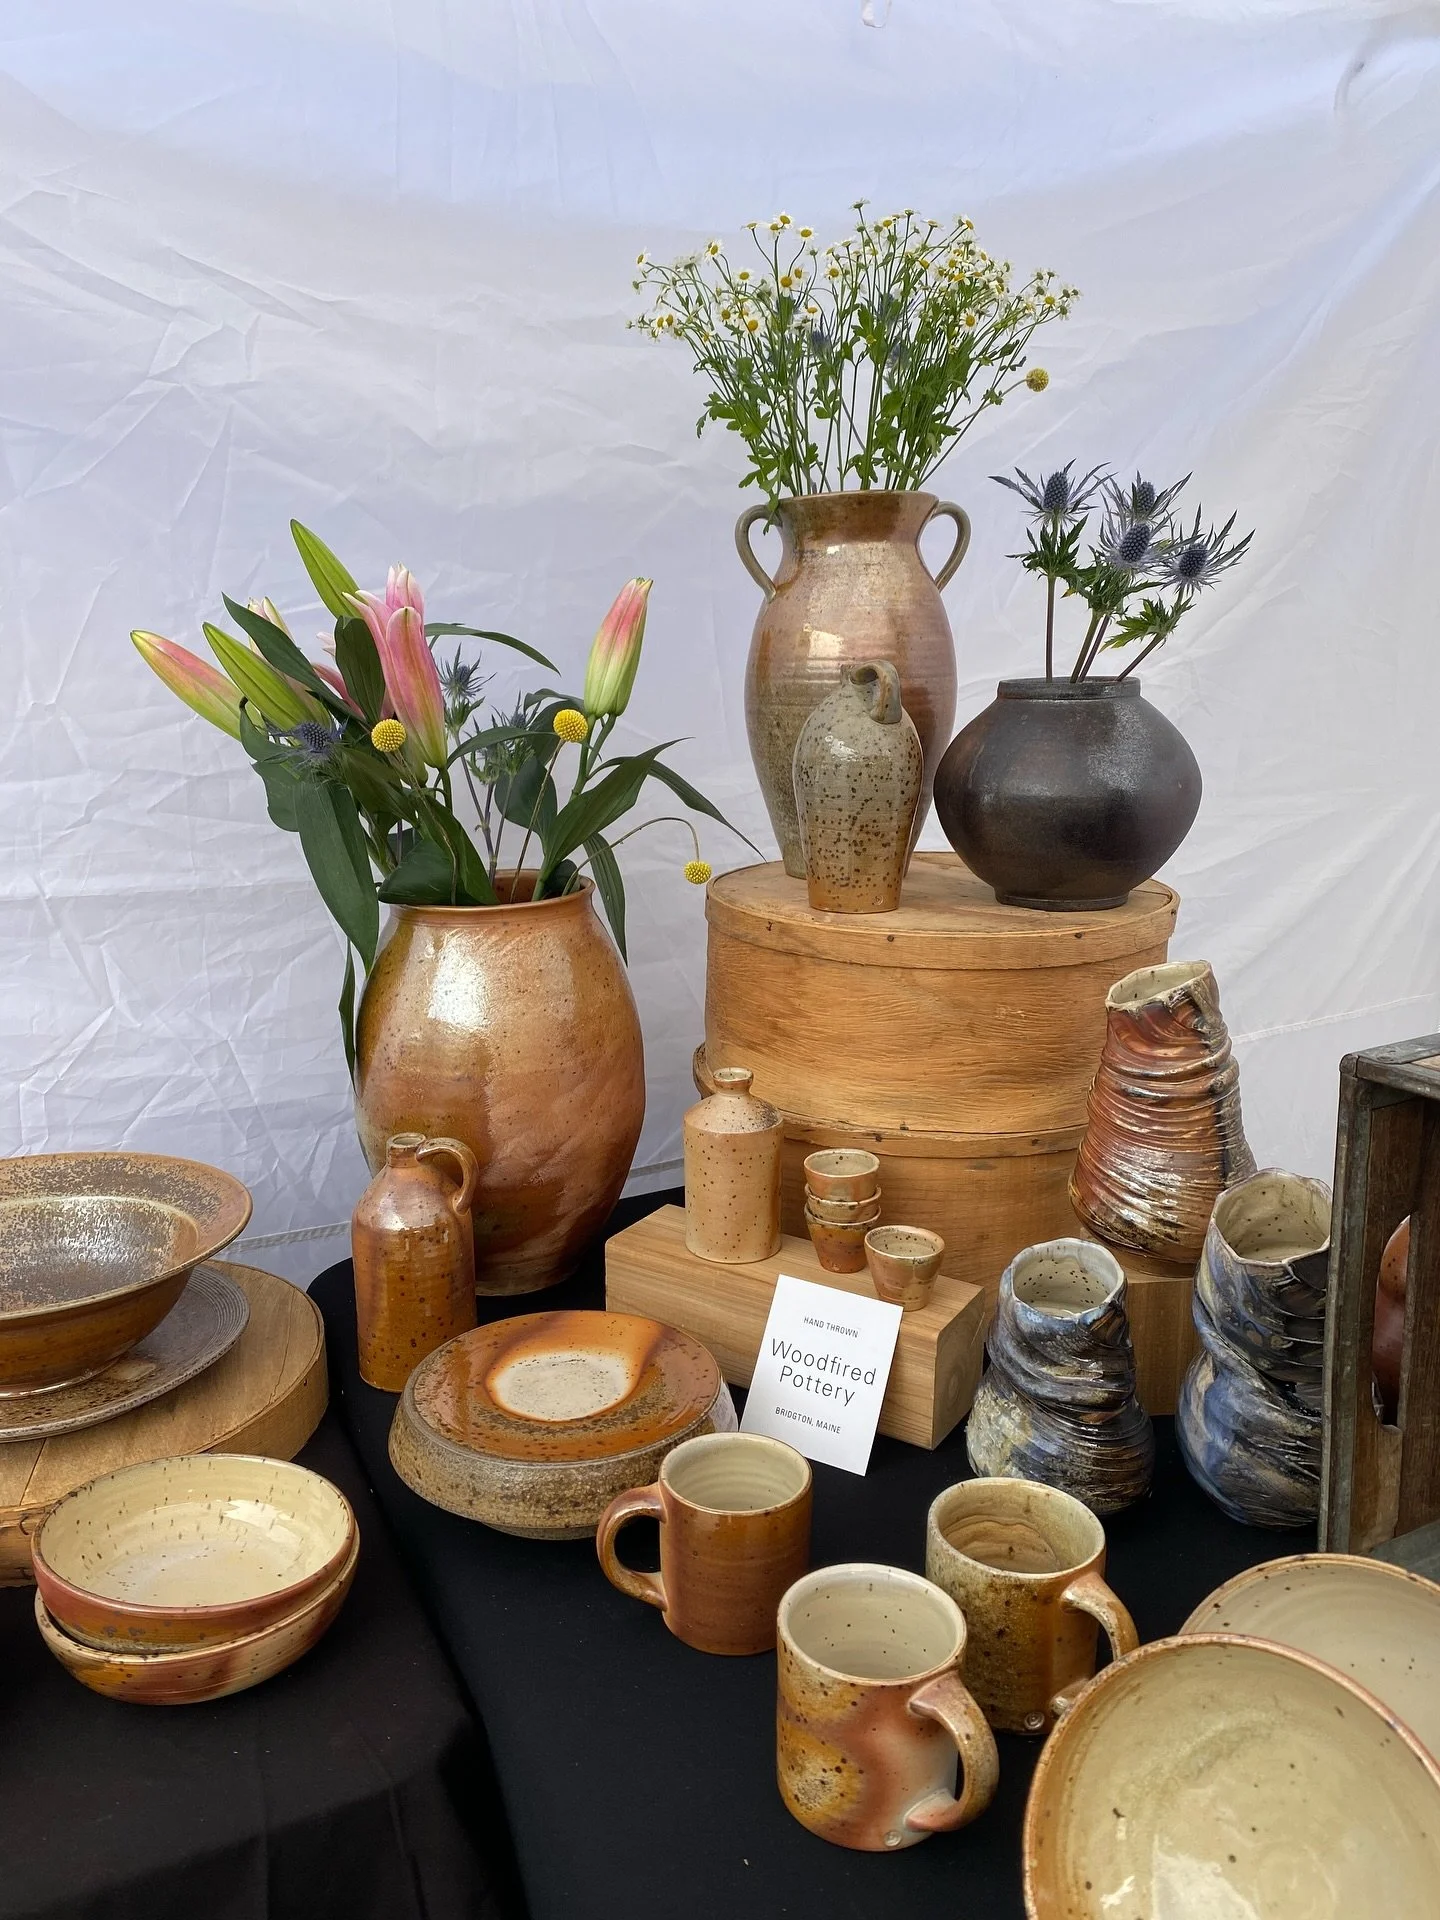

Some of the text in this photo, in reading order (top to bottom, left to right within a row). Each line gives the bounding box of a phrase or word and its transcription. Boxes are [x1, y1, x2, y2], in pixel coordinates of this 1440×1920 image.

[803, 1316, 859, 1338] HAND THROWN
[771, 1338, 876, 1386] Woodfired
[779, 1365, 855, 1407] Pottery
[775, 1406, 841, 1434] BRIDGTON, MAINE
